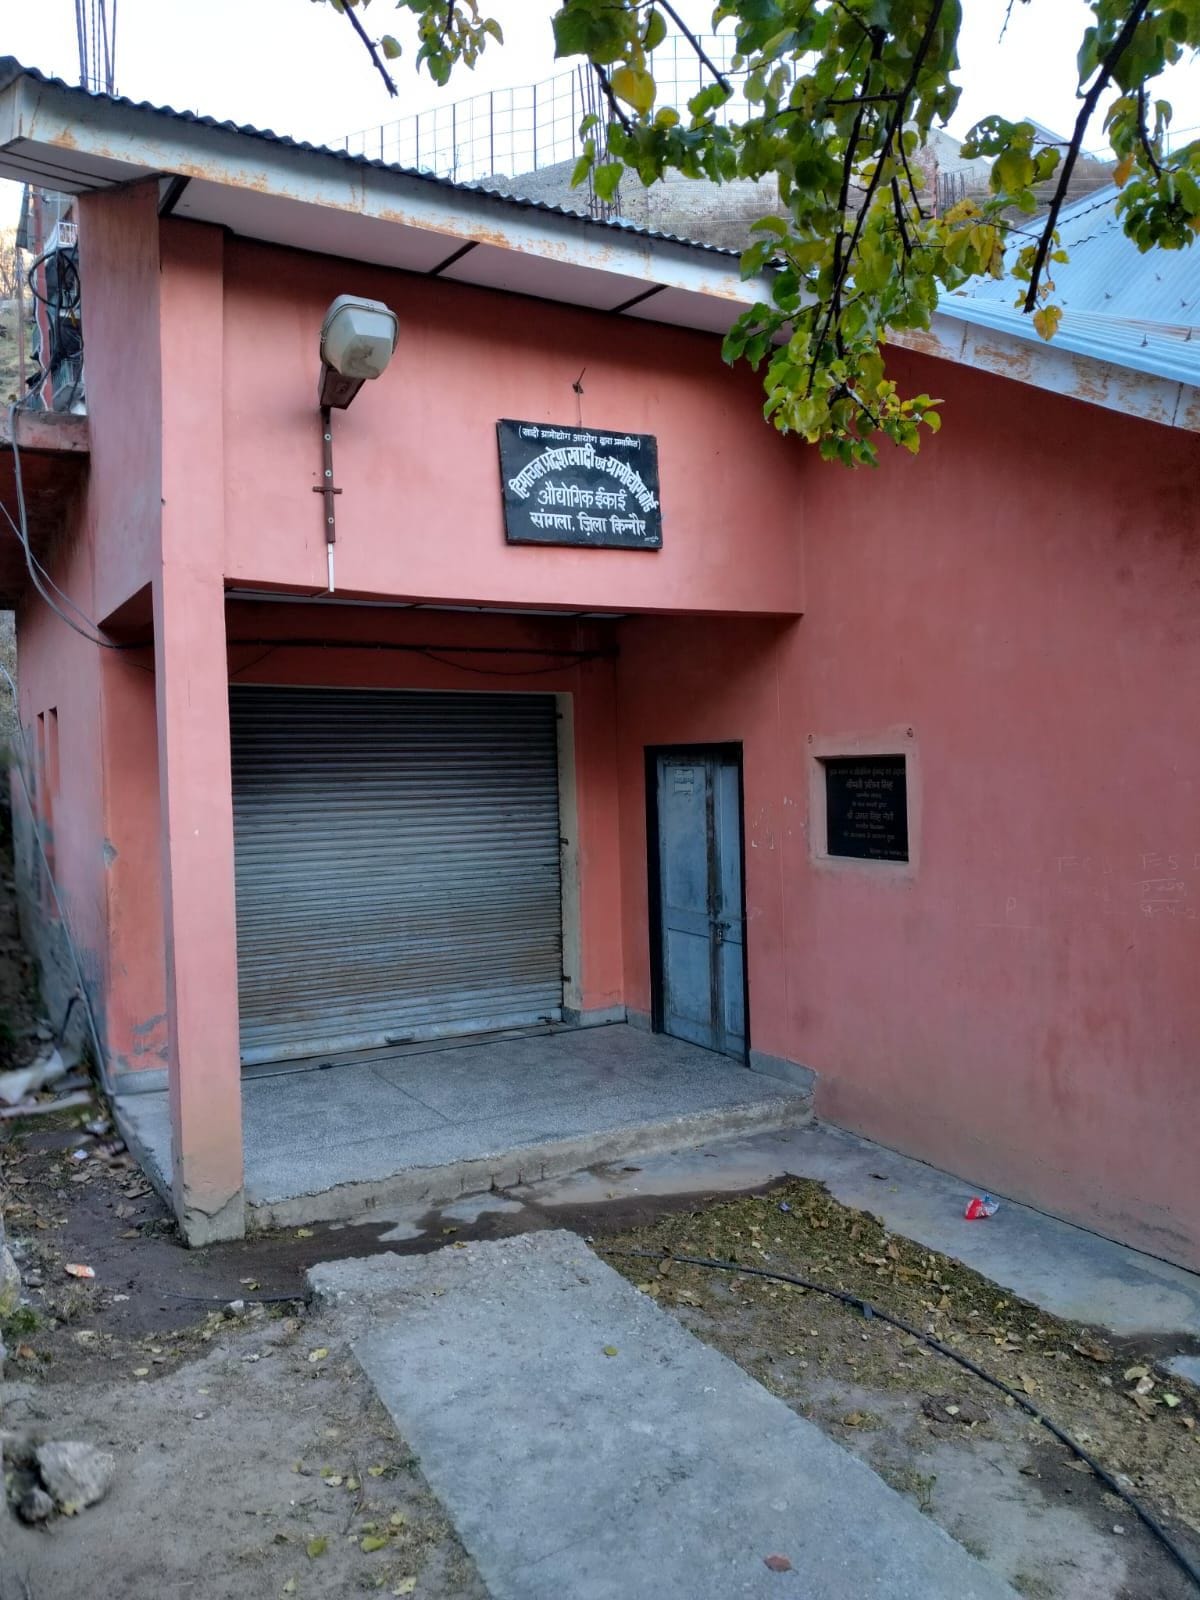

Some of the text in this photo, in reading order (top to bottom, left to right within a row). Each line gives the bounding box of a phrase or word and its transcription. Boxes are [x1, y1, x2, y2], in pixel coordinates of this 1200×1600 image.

[573, 432, 598, 443] आयोग
[508, 457, 547, 499] हिमाचल
[540, 446, 569, 471] प्रदेश
[567, 443, 596, 469] खादी
[595, 456, 608, 471] एवं
[606, 456, 647, 499] ग्रामोद्योग
[537, 480, 627, 511] औद्योगिक ईकाई
[609, 512, 647, 536] किन्नौर
